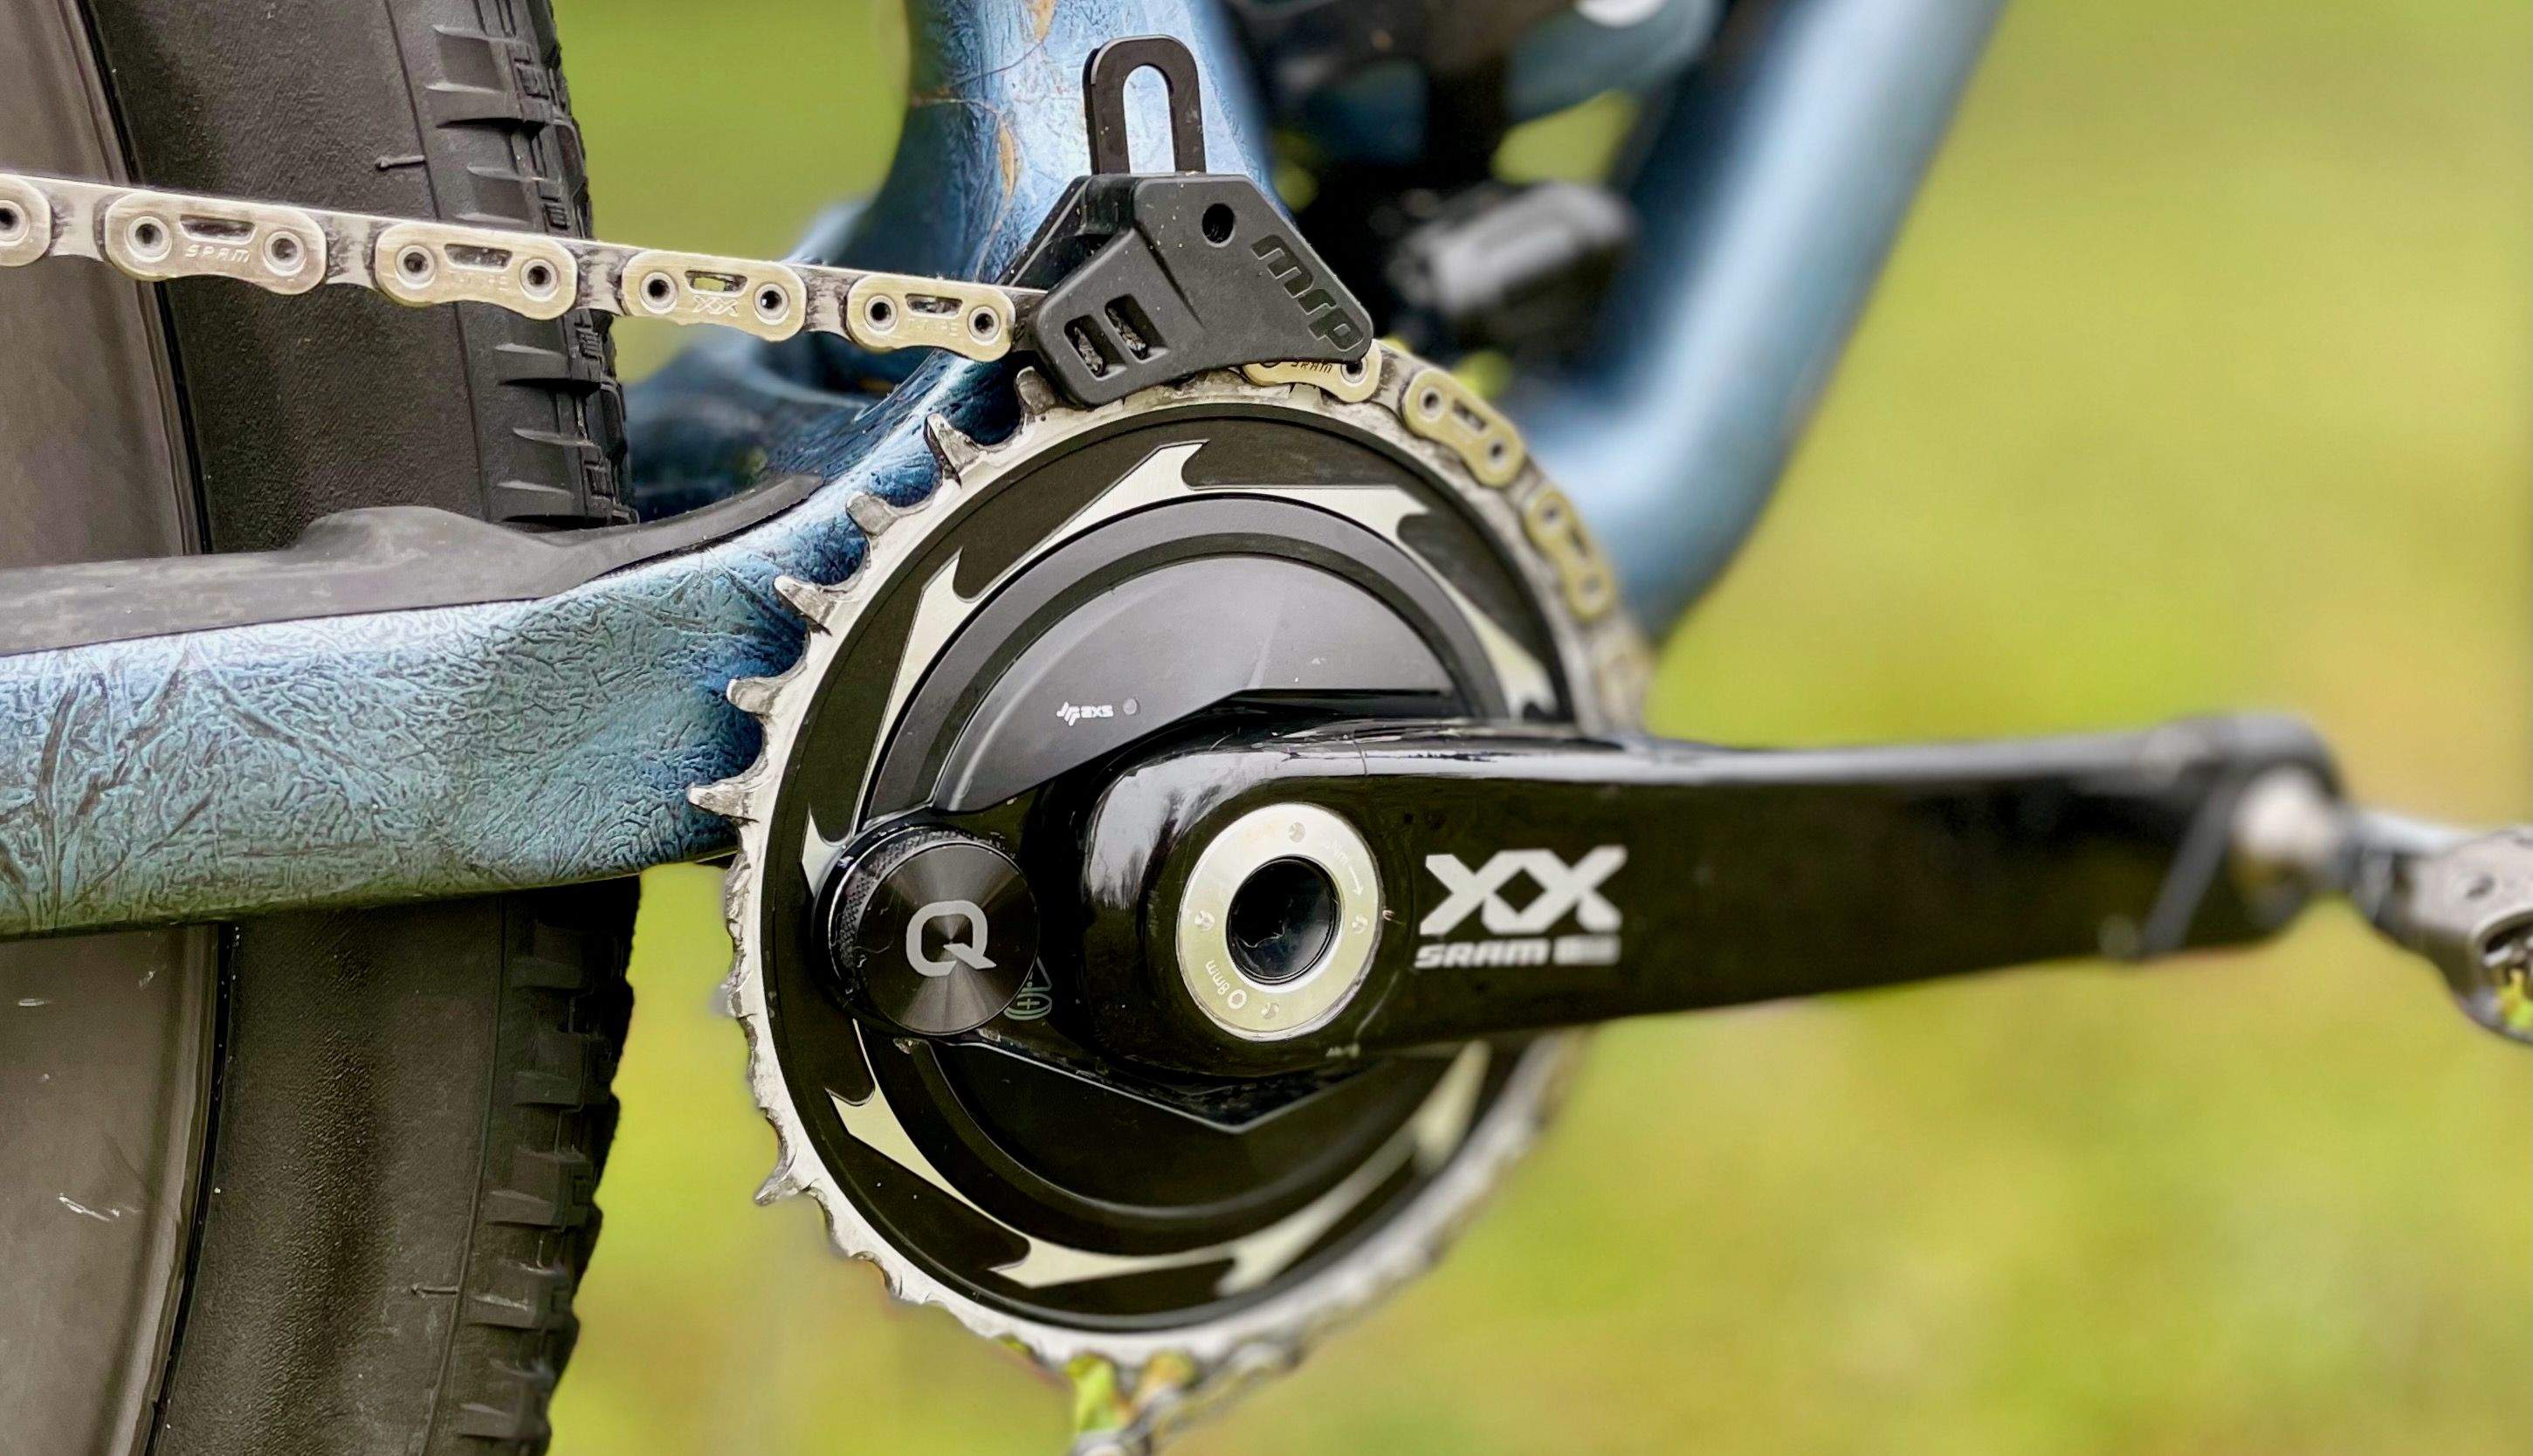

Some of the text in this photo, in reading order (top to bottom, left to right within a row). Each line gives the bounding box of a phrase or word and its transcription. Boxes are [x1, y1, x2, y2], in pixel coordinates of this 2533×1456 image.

[692, 295, 740, 317] XX
[1250, 234, 1365, 353] mrp
[1420, 845, 1628, 935] XX
[905, 900, 997, 978] Q
[1414, 938, 1551, 968] SRAM
